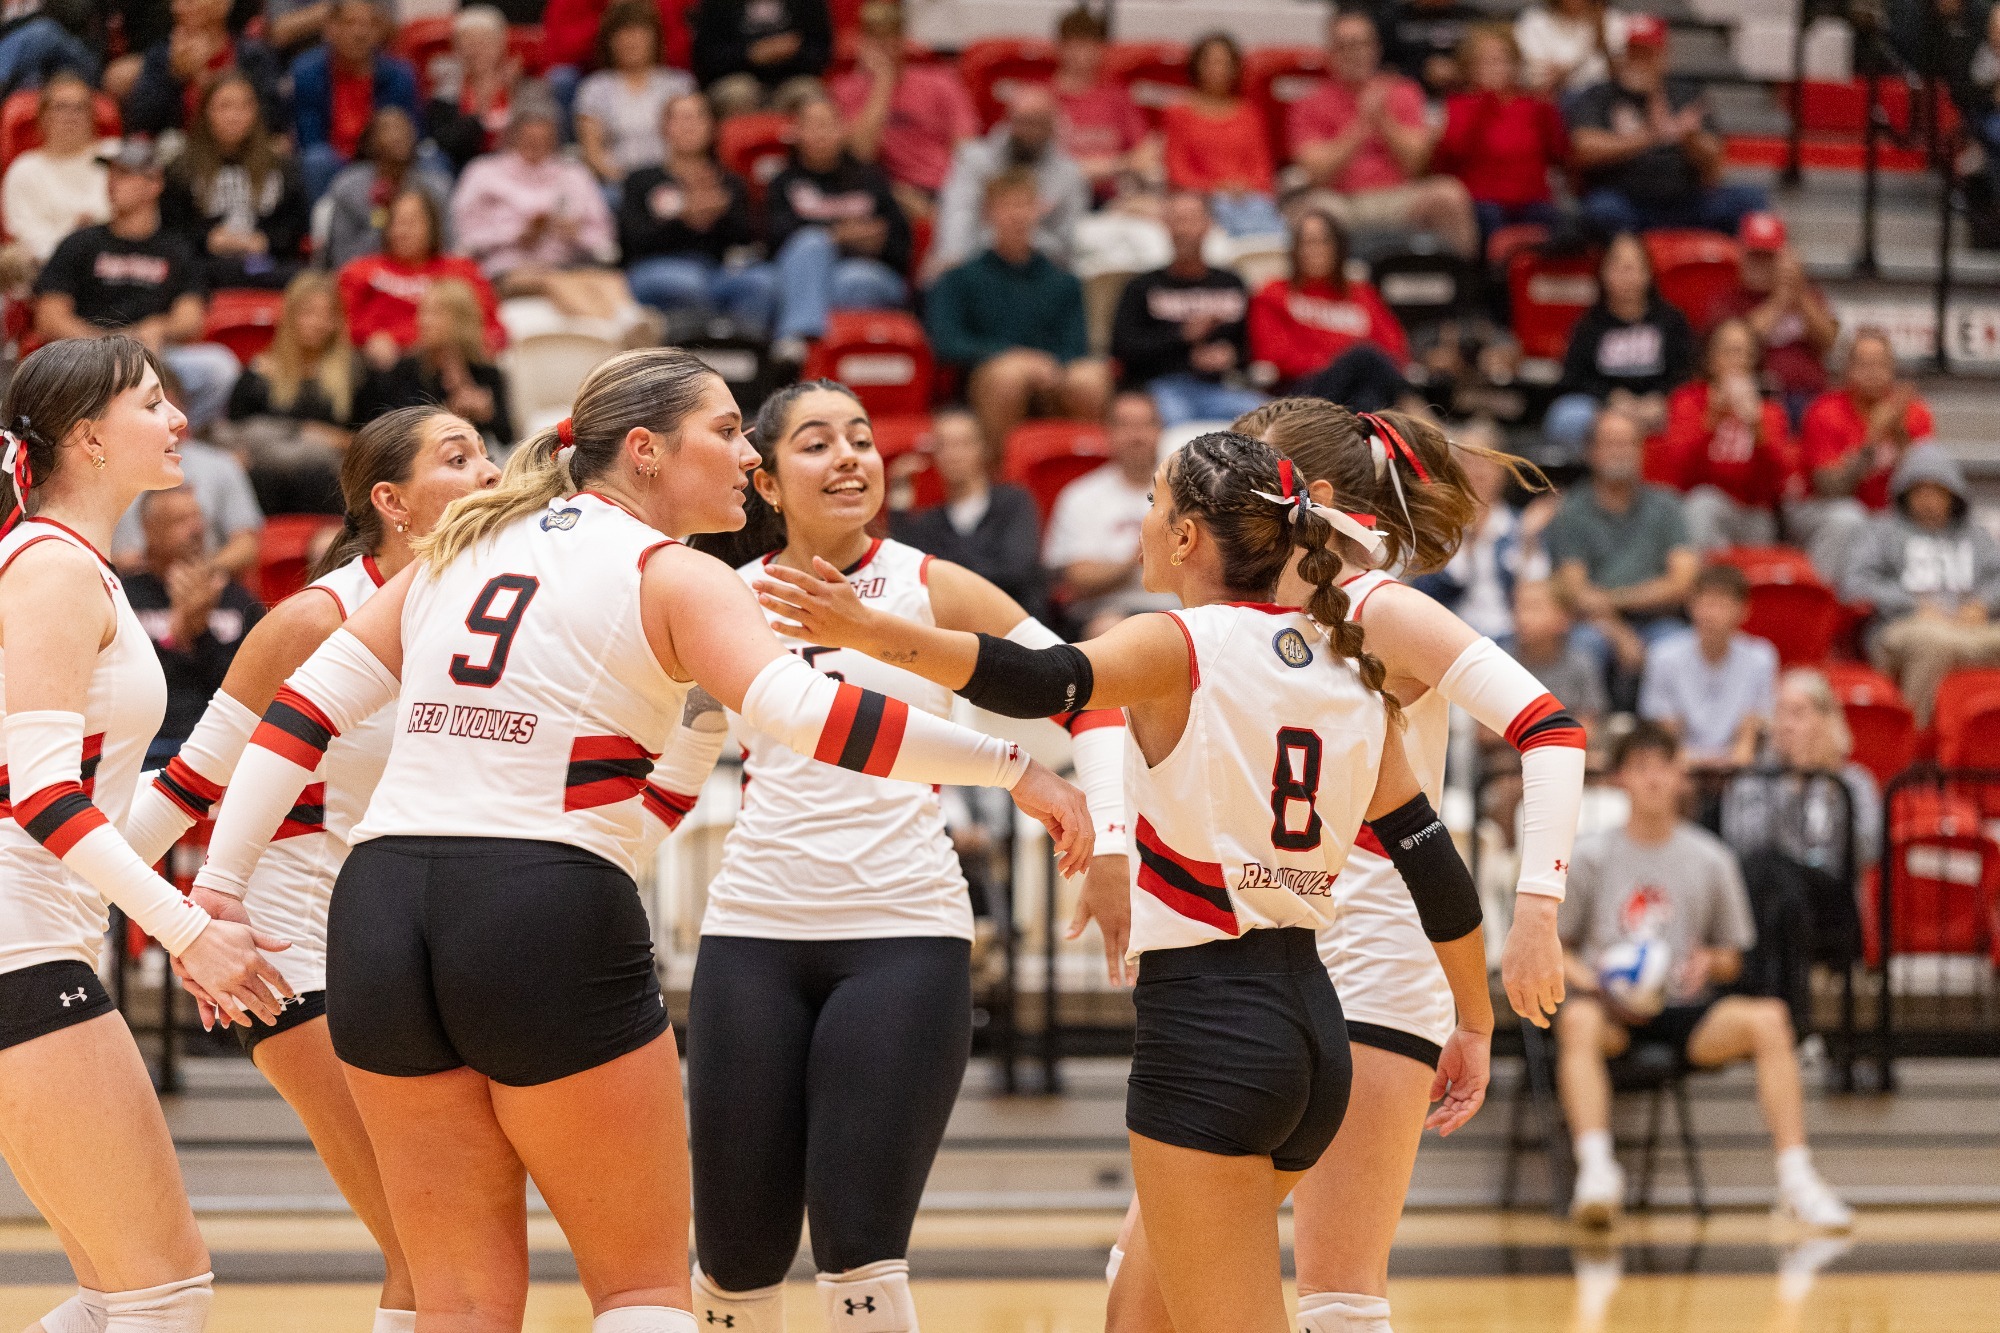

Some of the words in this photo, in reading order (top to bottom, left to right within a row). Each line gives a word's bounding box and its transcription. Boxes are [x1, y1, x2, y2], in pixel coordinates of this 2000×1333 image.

[448, 573, 540, 688] 9
[407, 702, 448, 733] RED
[449, 705, 538, 744] WOLVES
[1271, 726, 1322, 852] 8
